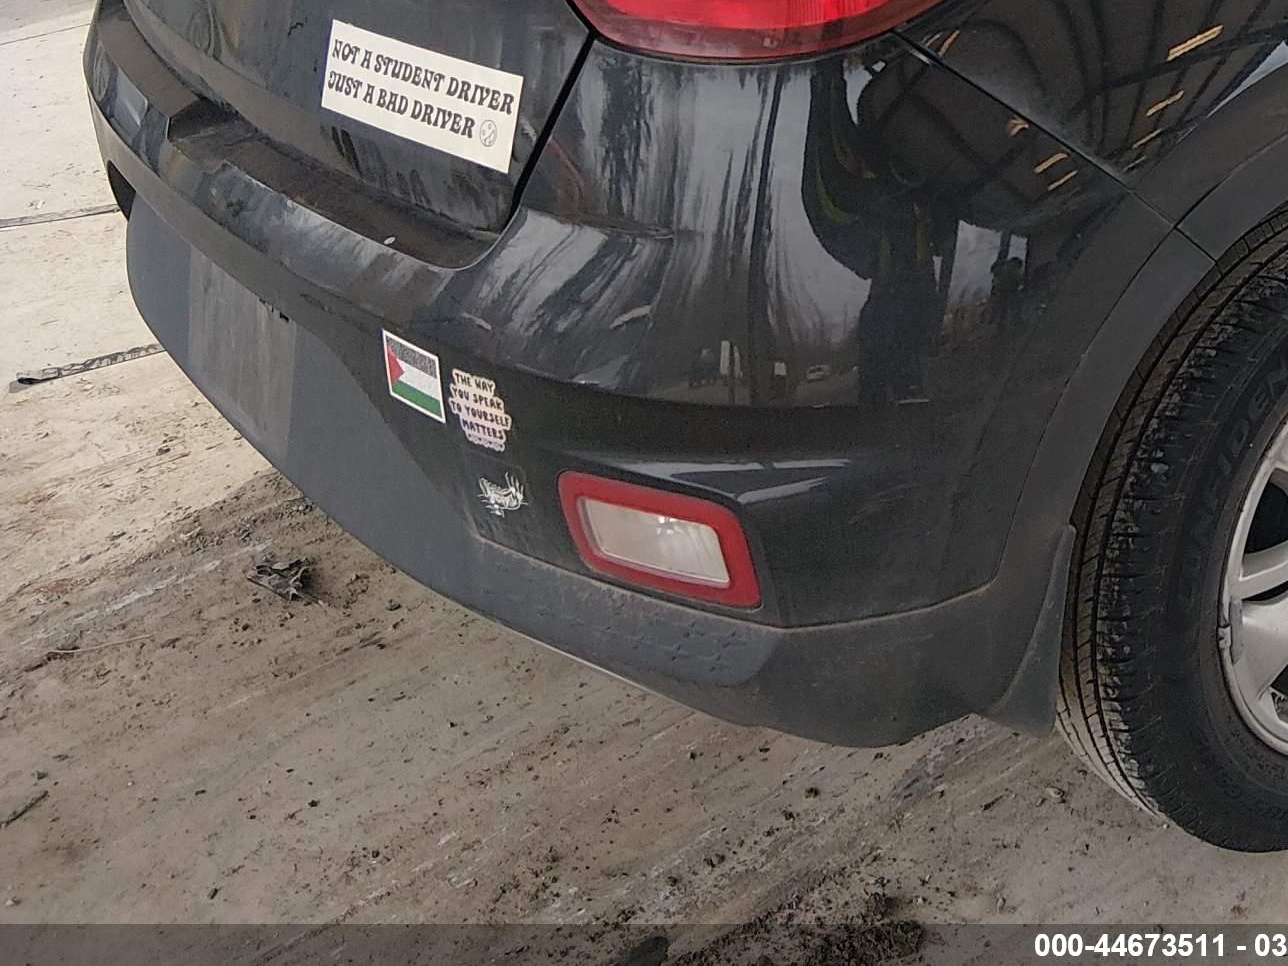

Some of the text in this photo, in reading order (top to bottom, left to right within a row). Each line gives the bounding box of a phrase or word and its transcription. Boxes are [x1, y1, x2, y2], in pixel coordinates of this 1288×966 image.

[331, 38, 515, 115] NOT A STUDENT DRIVER
[327, 70, 476, 138] JUST A BAD DRIVER
[454, 372, 494, 393] THE WAY
[451, 386, 503, 411] YOU SPEAK
[451, 401, 510, 428] TO YOURSELF
[462, 418, 504, 441] MATTERS
